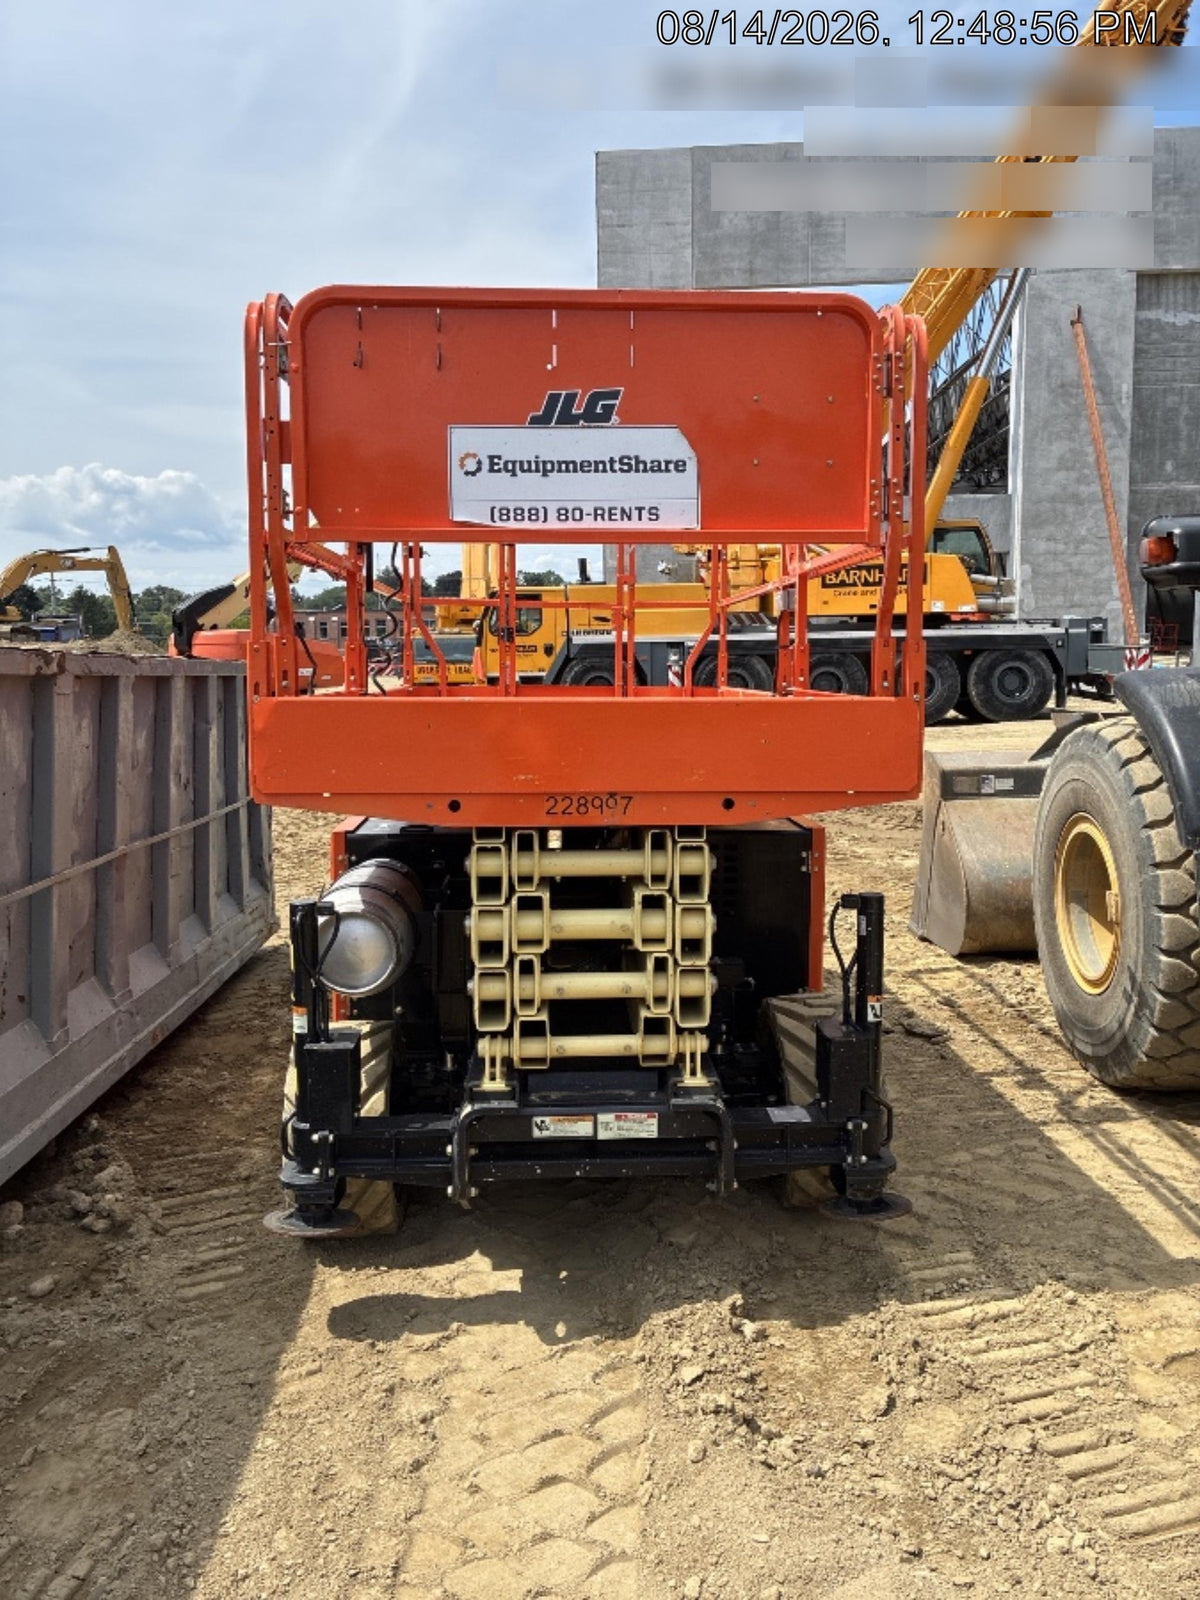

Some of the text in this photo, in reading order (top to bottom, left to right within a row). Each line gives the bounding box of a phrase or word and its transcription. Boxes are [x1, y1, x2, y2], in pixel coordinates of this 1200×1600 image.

[527, 387, 624, 426] JLG
[487, 454, 688, 477] EquipmentShare
[490, 506, 660, 522] (888) 80-RENTS
